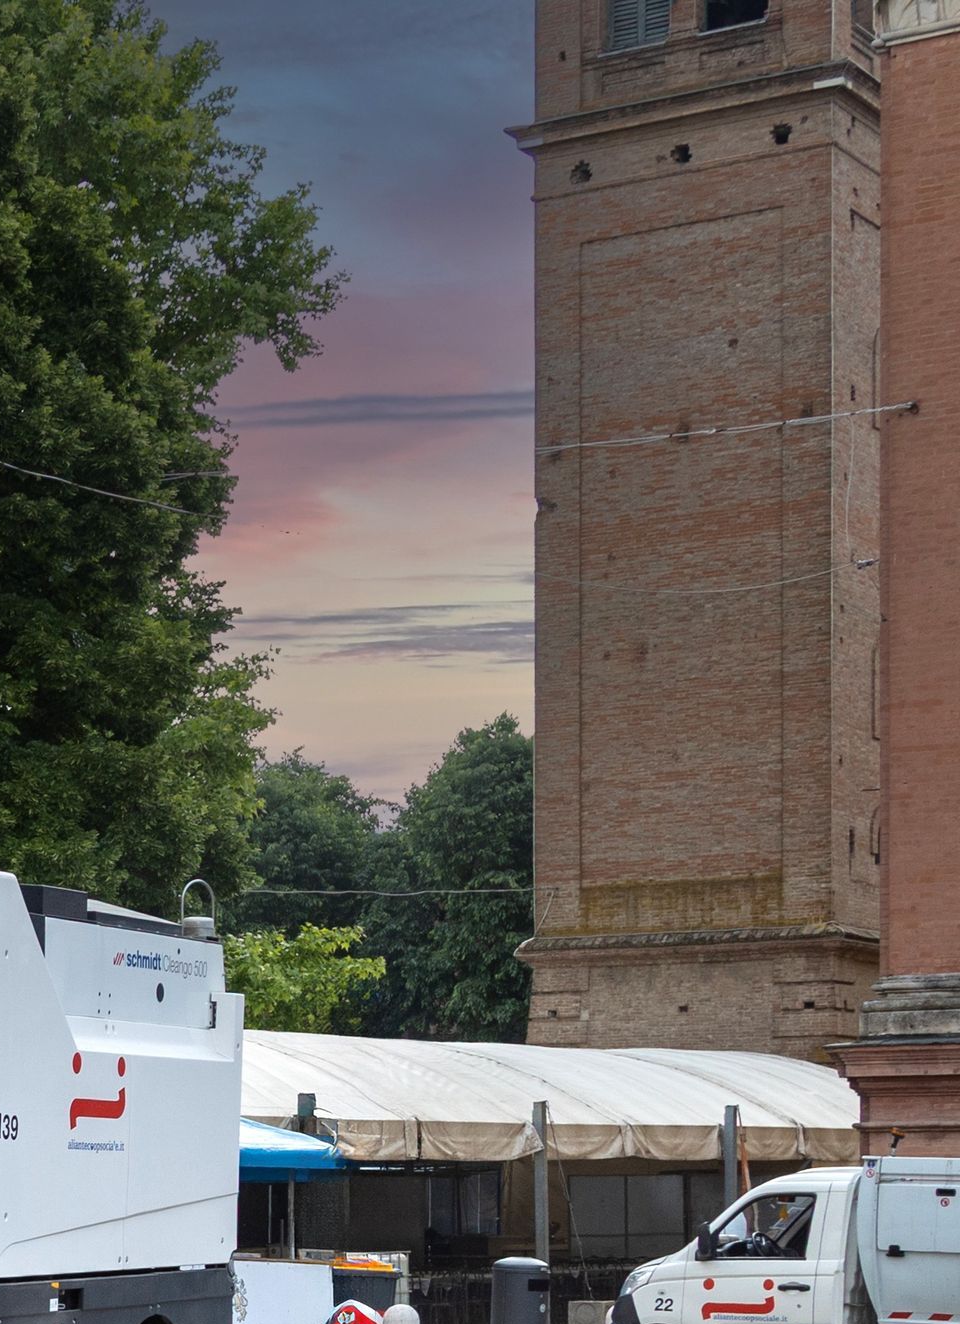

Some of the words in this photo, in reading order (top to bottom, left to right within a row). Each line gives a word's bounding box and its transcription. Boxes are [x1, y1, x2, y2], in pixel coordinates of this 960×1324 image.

[126, 950, 161, 970] schmidt
[163, 955, 193, 979] Cleango
[194, 961, 208, 978] 500
[654, 1298, 674, 1312] 22
